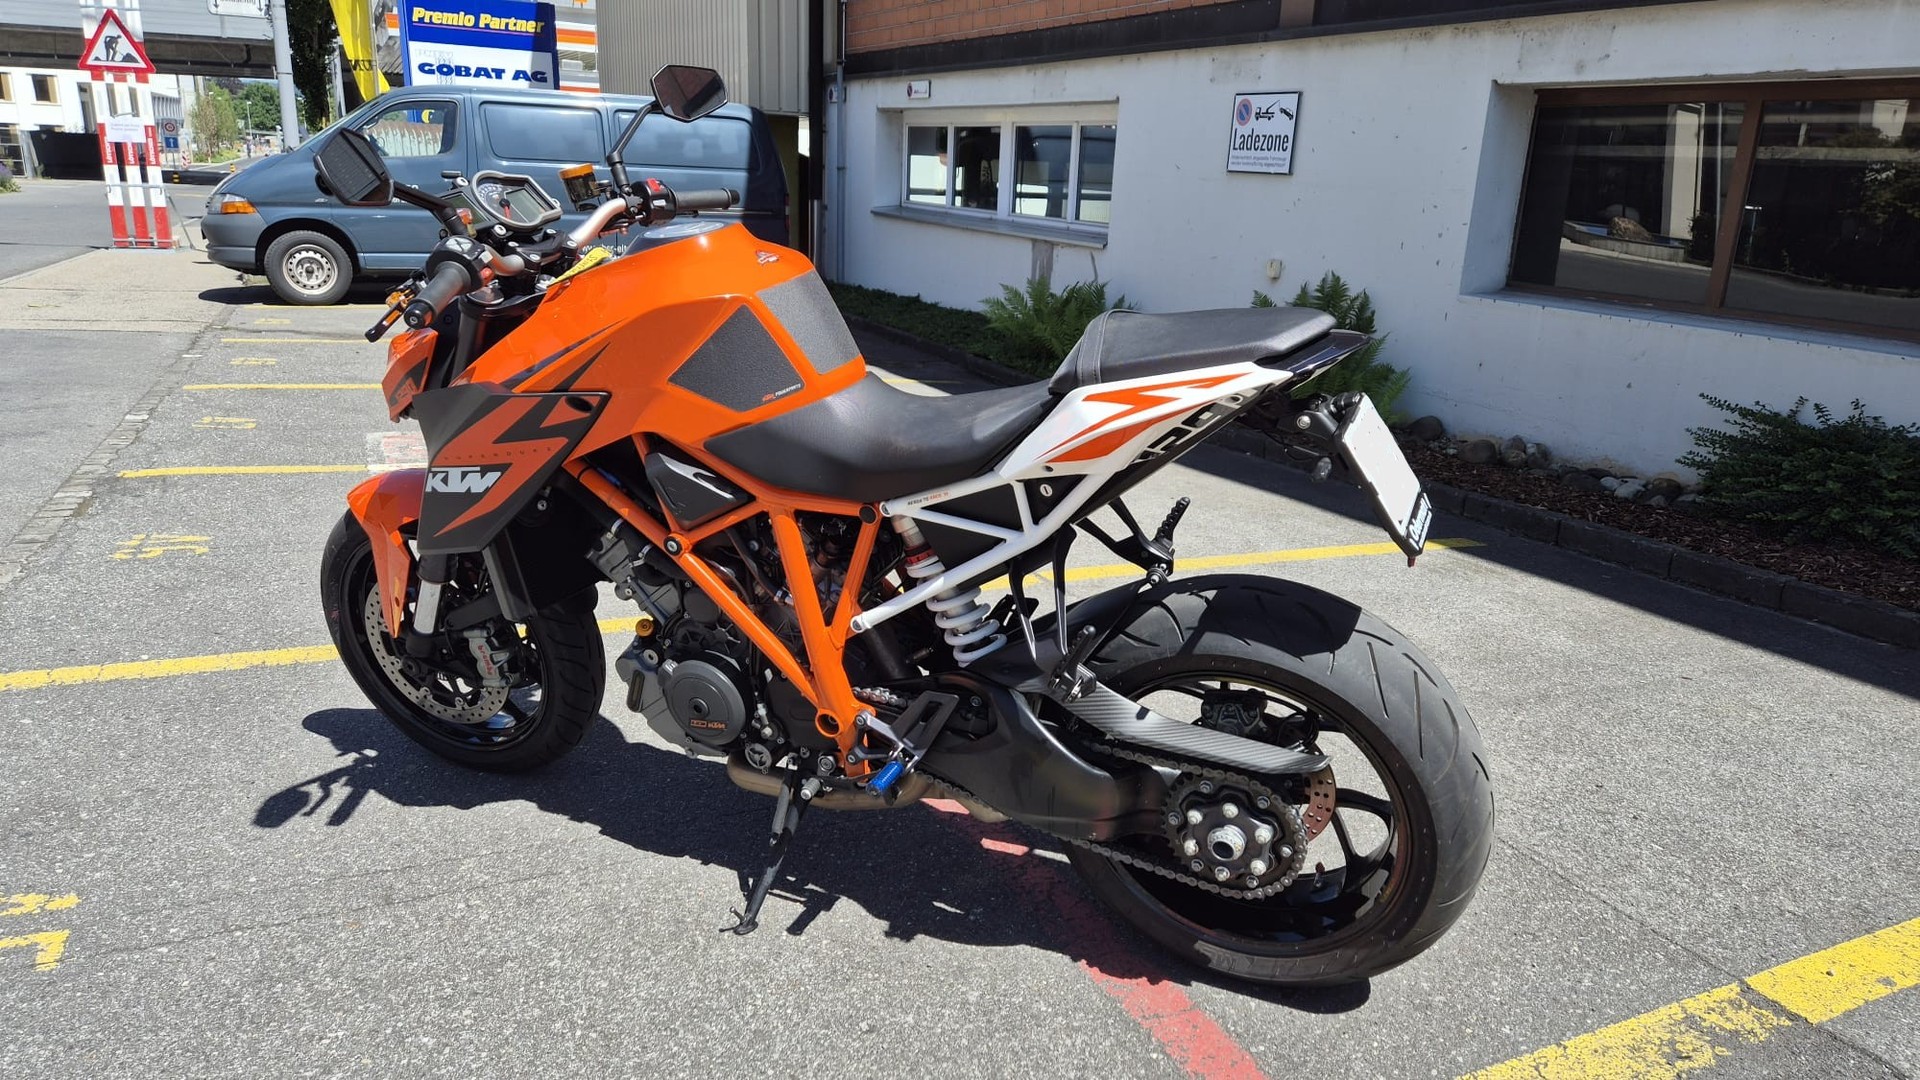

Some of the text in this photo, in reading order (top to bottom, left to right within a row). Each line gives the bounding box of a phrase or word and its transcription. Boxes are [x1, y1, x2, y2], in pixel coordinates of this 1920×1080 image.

[412, 7, 545, 33] Premio Partner
[417, 62, 548, 83] GOBAT AG
[1232, 127, 1289, 152] Ladezone
[425, 466, 502, 493] KTM
